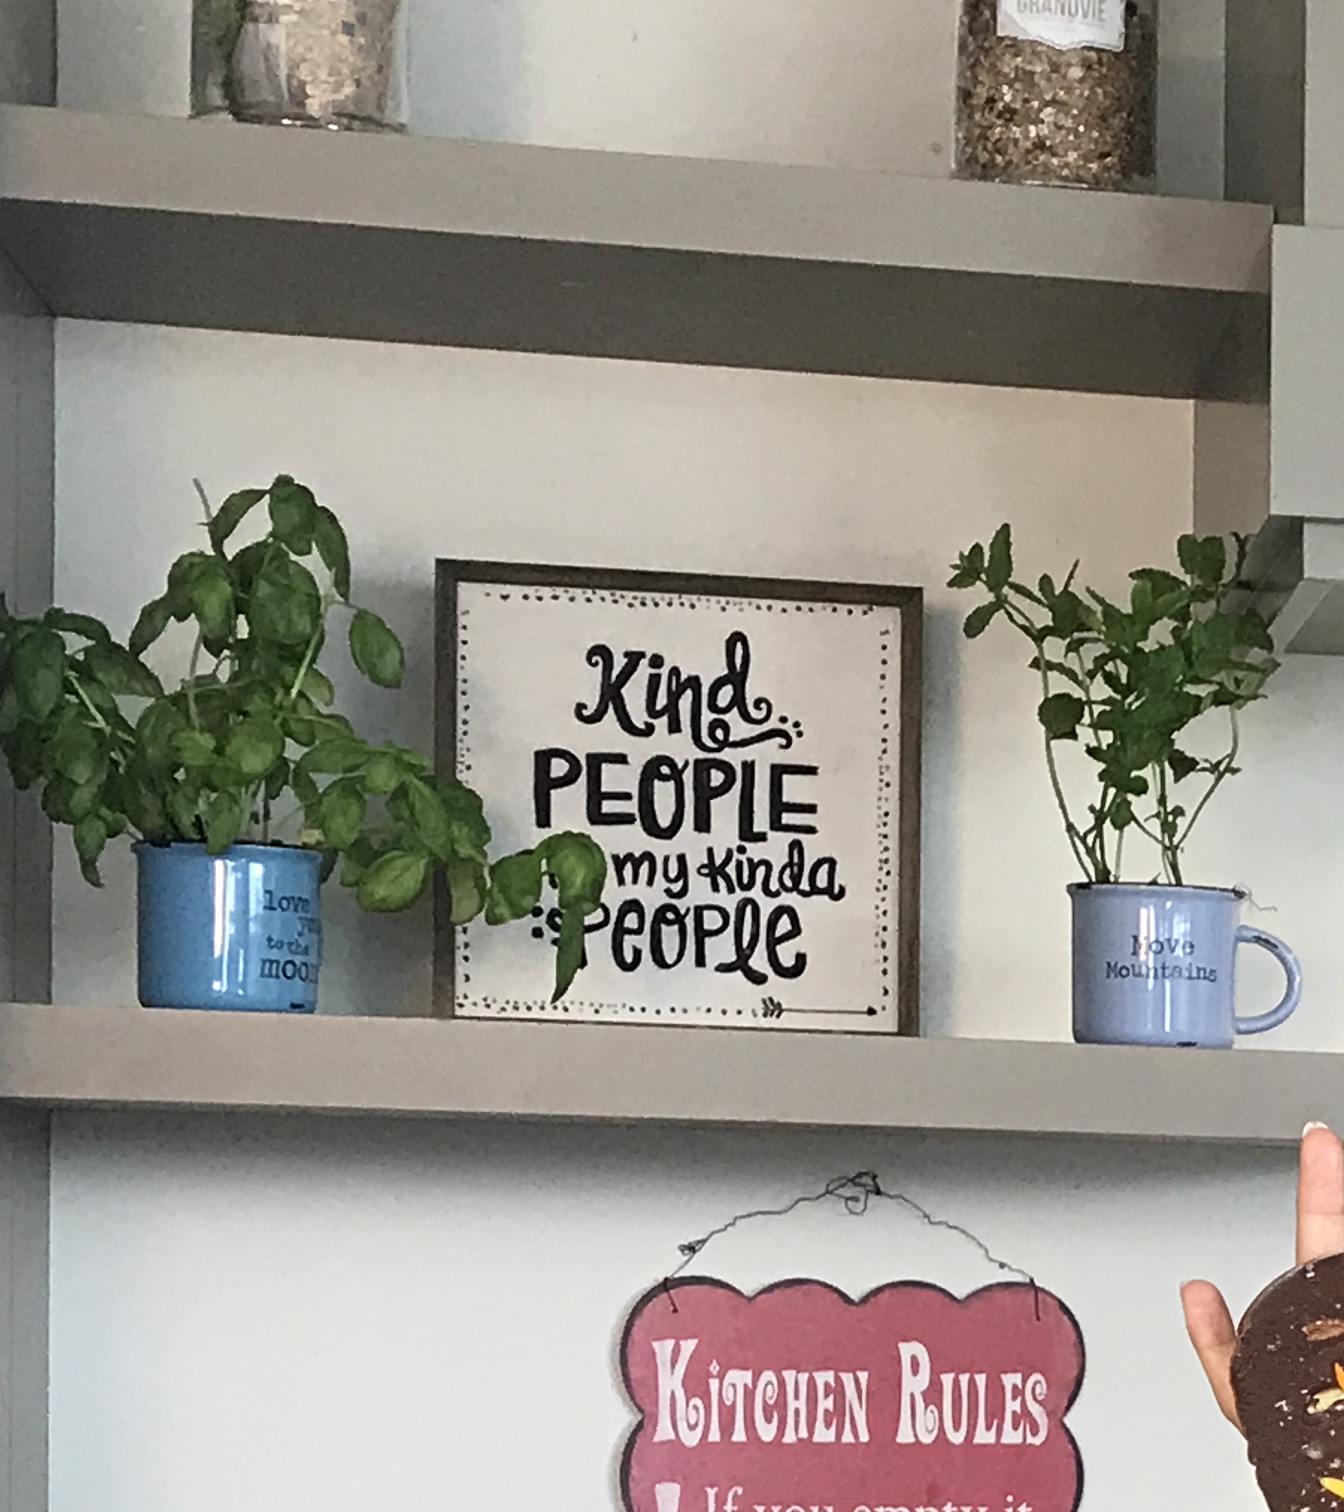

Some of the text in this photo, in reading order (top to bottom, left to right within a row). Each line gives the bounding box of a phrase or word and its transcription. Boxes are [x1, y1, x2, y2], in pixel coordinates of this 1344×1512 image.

[574, 630, 794, 753] Kind
[533, 747, 820, 843] PEOPLE
[611, 850, 690, 899] my
[1105, 961, 1218, 983] Mountains
